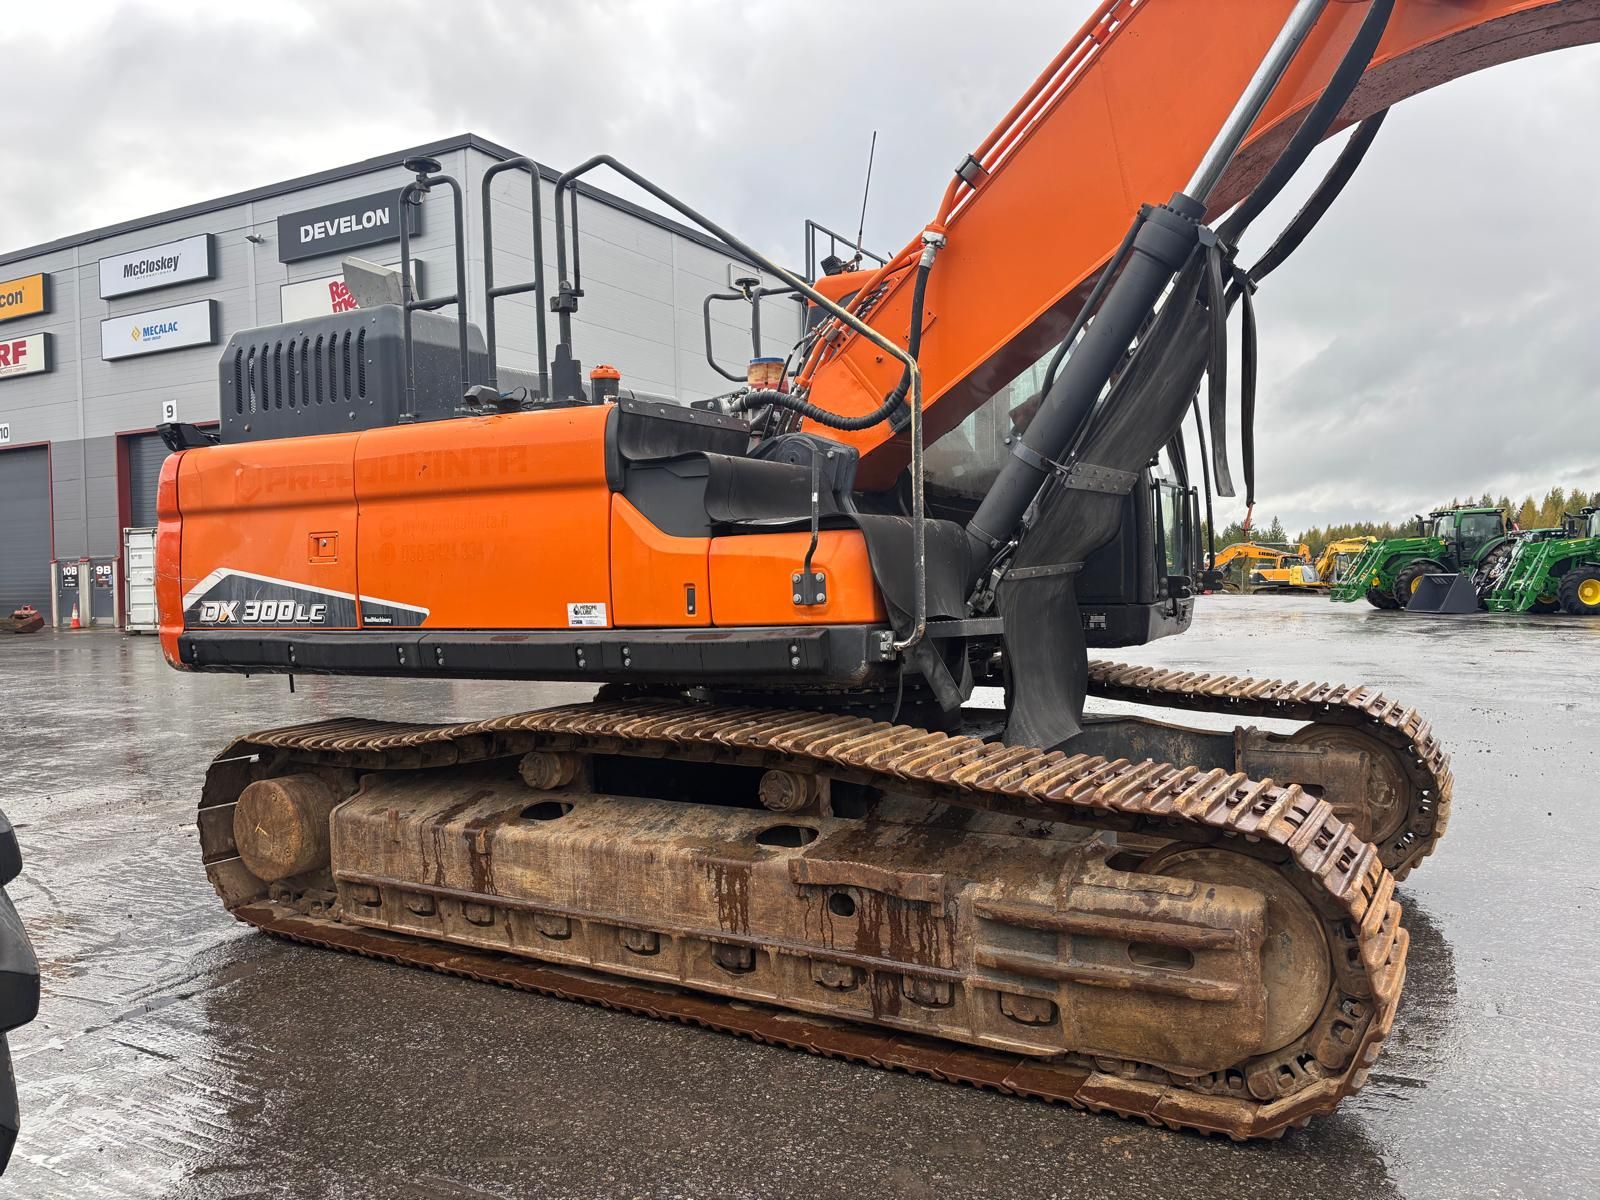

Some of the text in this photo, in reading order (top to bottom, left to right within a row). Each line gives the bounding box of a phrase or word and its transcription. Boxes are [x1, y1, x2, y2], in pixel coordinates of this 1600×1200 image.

[300, 207, 390, 243] DEVELON
[123, 255, 180, 278] McCloskey
[142, 321, 179, 337] MECALAC
[165, 404, 174, 419] 9
[62, 566, 78, 576] 10B
[95, 565, 112, 575] 9B
[201, 600, 240, 624] DX
